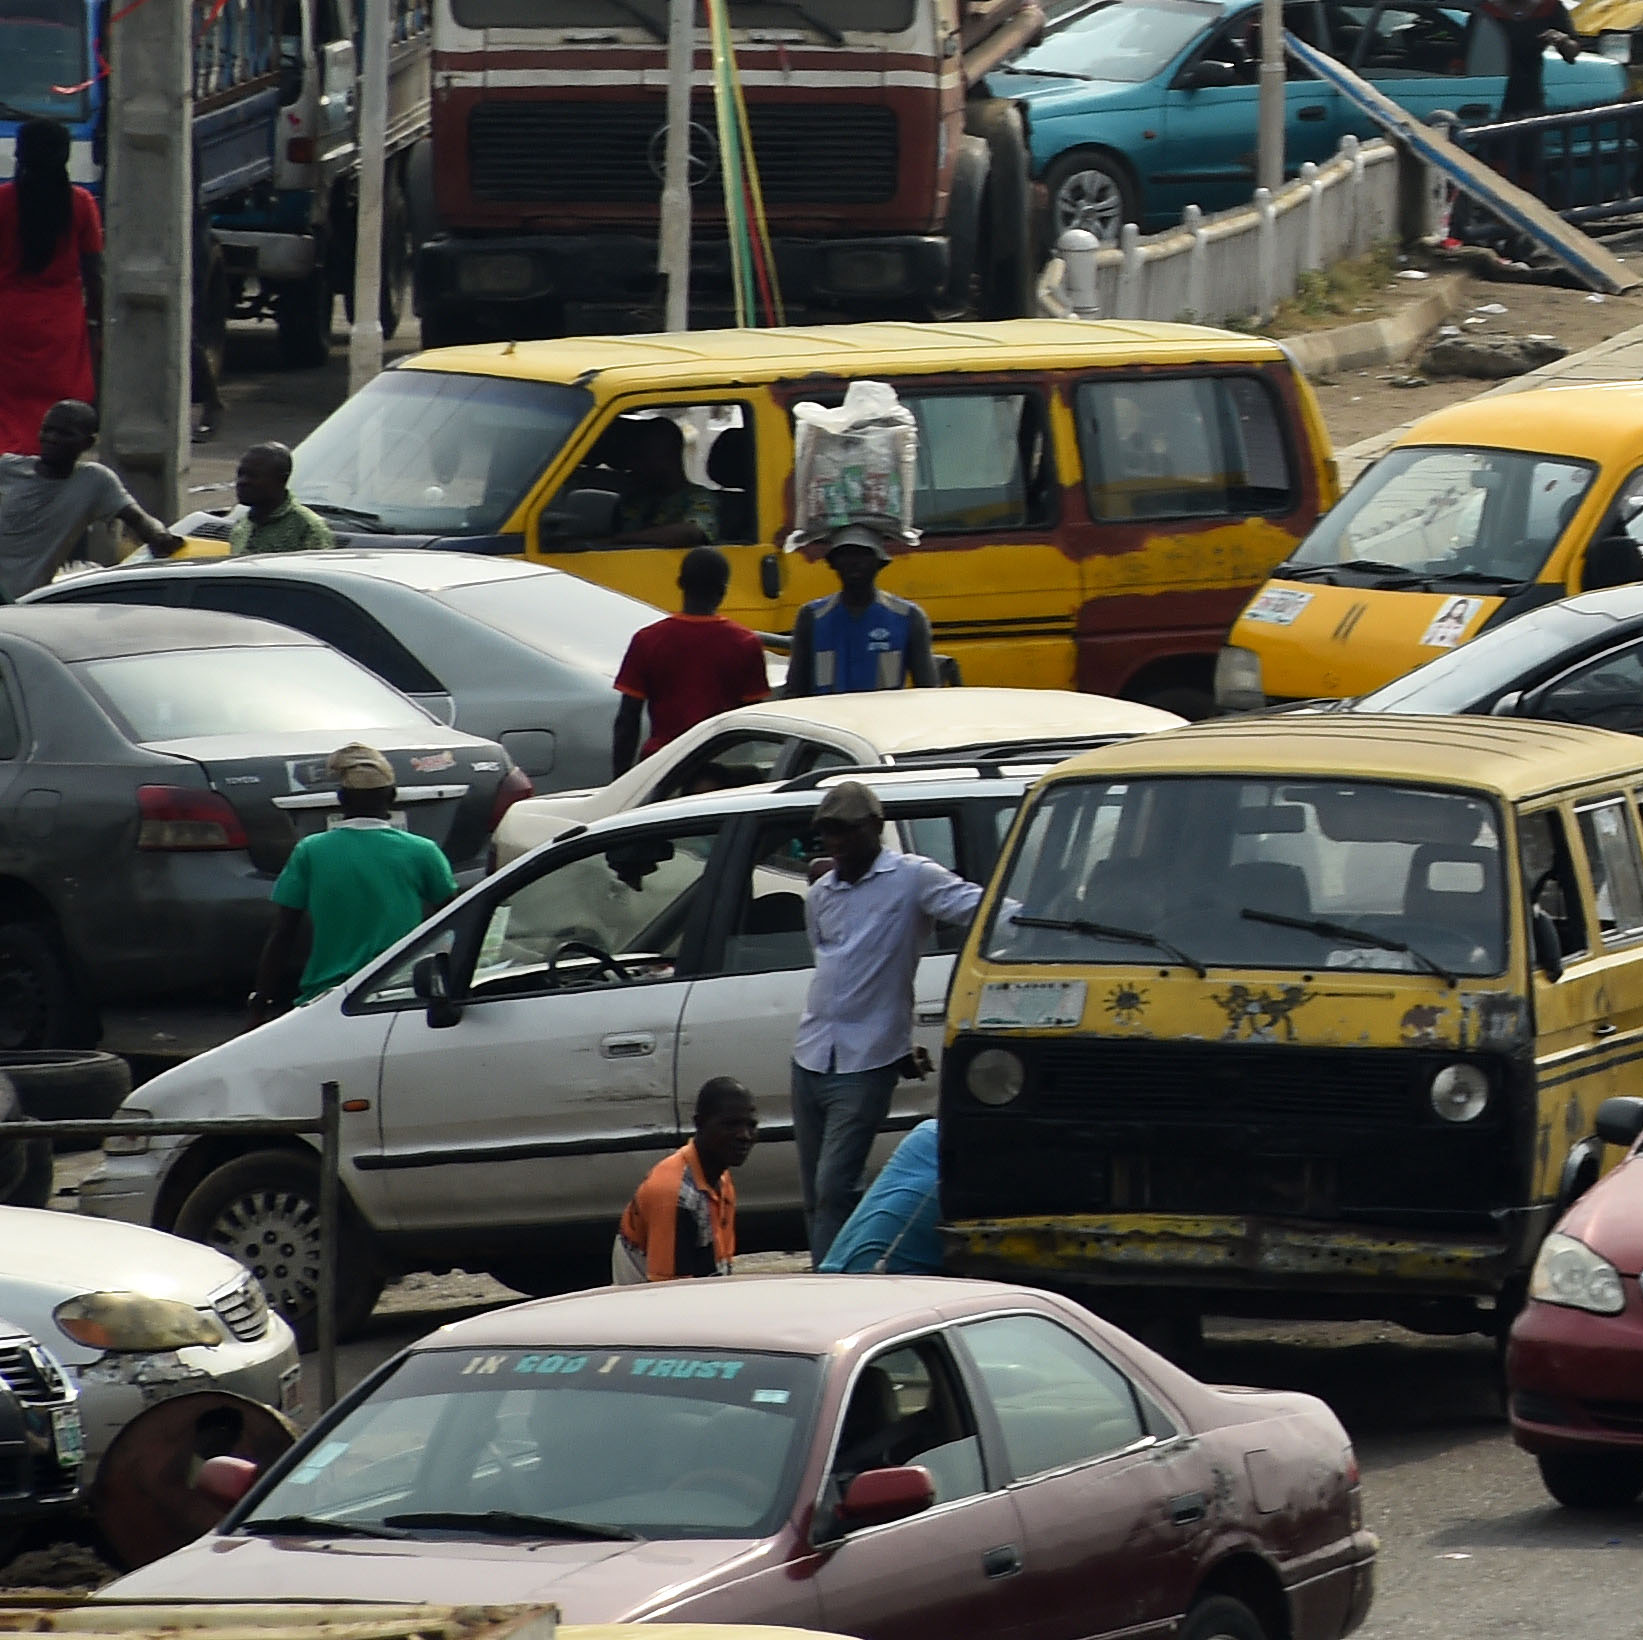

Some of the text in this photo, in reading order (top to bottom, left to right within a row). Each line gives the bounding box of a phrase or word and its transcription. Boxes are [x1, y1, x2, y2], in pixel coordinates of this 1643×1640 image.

[461, 1353, 745, 1380] IN GOD I TRUST
